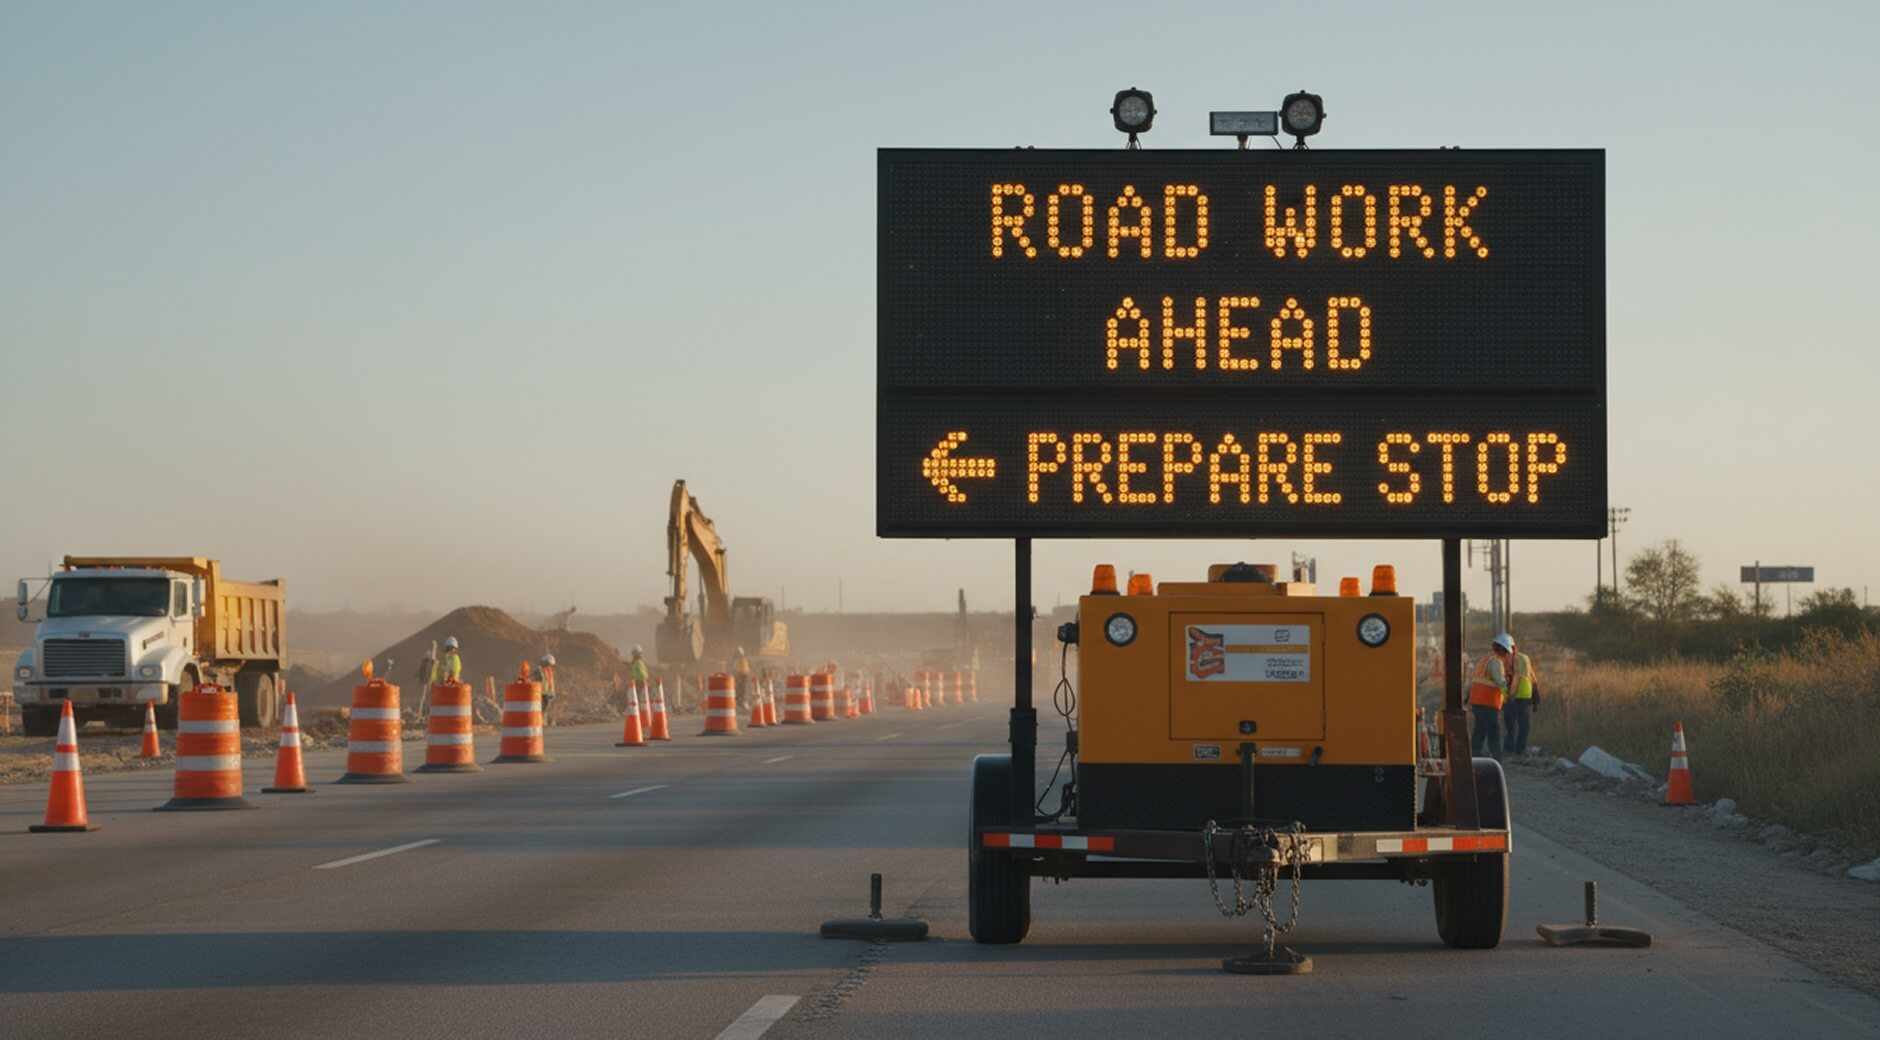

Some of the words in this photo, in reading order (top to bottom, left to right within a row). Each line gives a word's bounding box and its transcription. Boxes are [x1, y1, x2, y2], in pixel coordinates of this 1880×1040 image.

[991, 183, 1209, 258] ROAD
[1264, 184, 1489, 259] WORK
[1106, 296, 1371, 370] AHEAD
[1028, 432, 1342, 504] PREPARE
[1377, 432, 1567, 504] STOP
